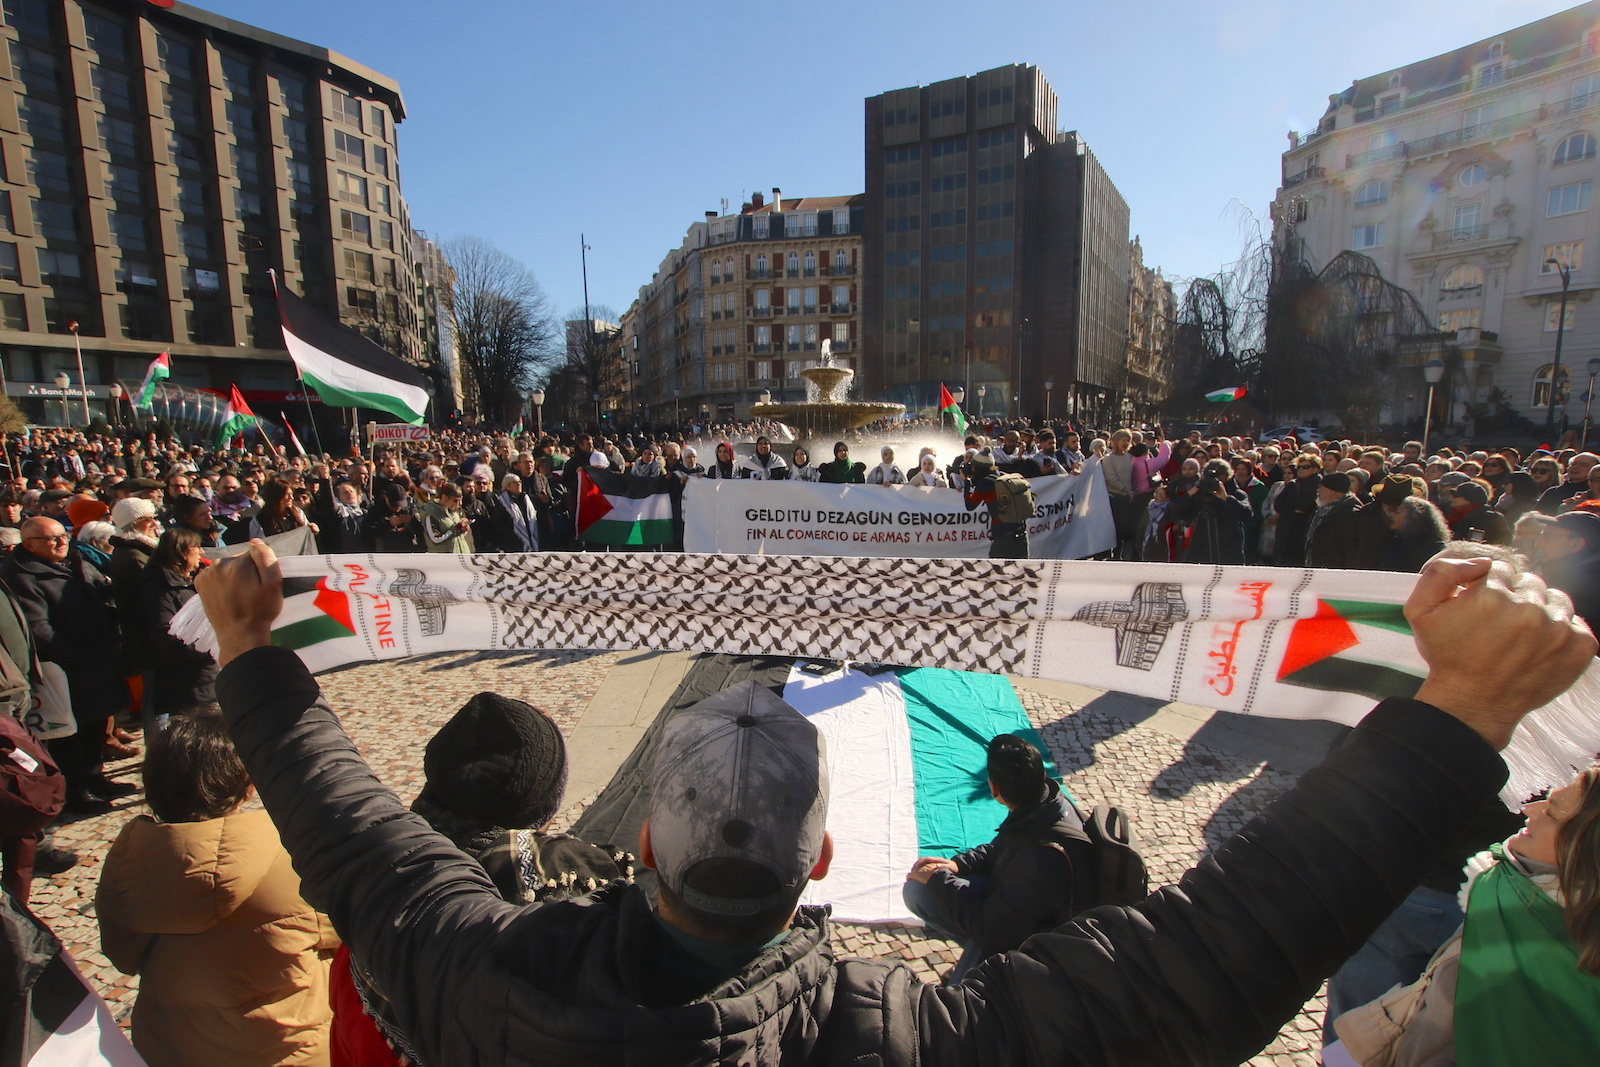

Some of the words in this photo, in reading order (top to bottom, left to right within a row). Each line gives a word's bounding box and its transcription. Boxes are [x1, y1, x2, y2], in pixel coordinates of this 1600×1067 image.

[41, 388, 96, 397] BancMach
[745, 508, 811, 523] GELDITU
[816, 510, 893, 526] DEZAGUN
[746, 528, 767, 540] FIN
[769, 529, 785, 540] AL
[786, 529, 849, 542] COMERCIO
[852, 532, 868, 542] DE
[870, 531, 911, 543] ARMAS
[915, 532, 922, 543] Y
[926, 532, 934, 542] A
[937, 530, 958, 542] LAS
[961, 530, 993, 541] RELAC
[1029, 522, 1051, 535] CON
[343, 564, 396, 650] PALTINE
